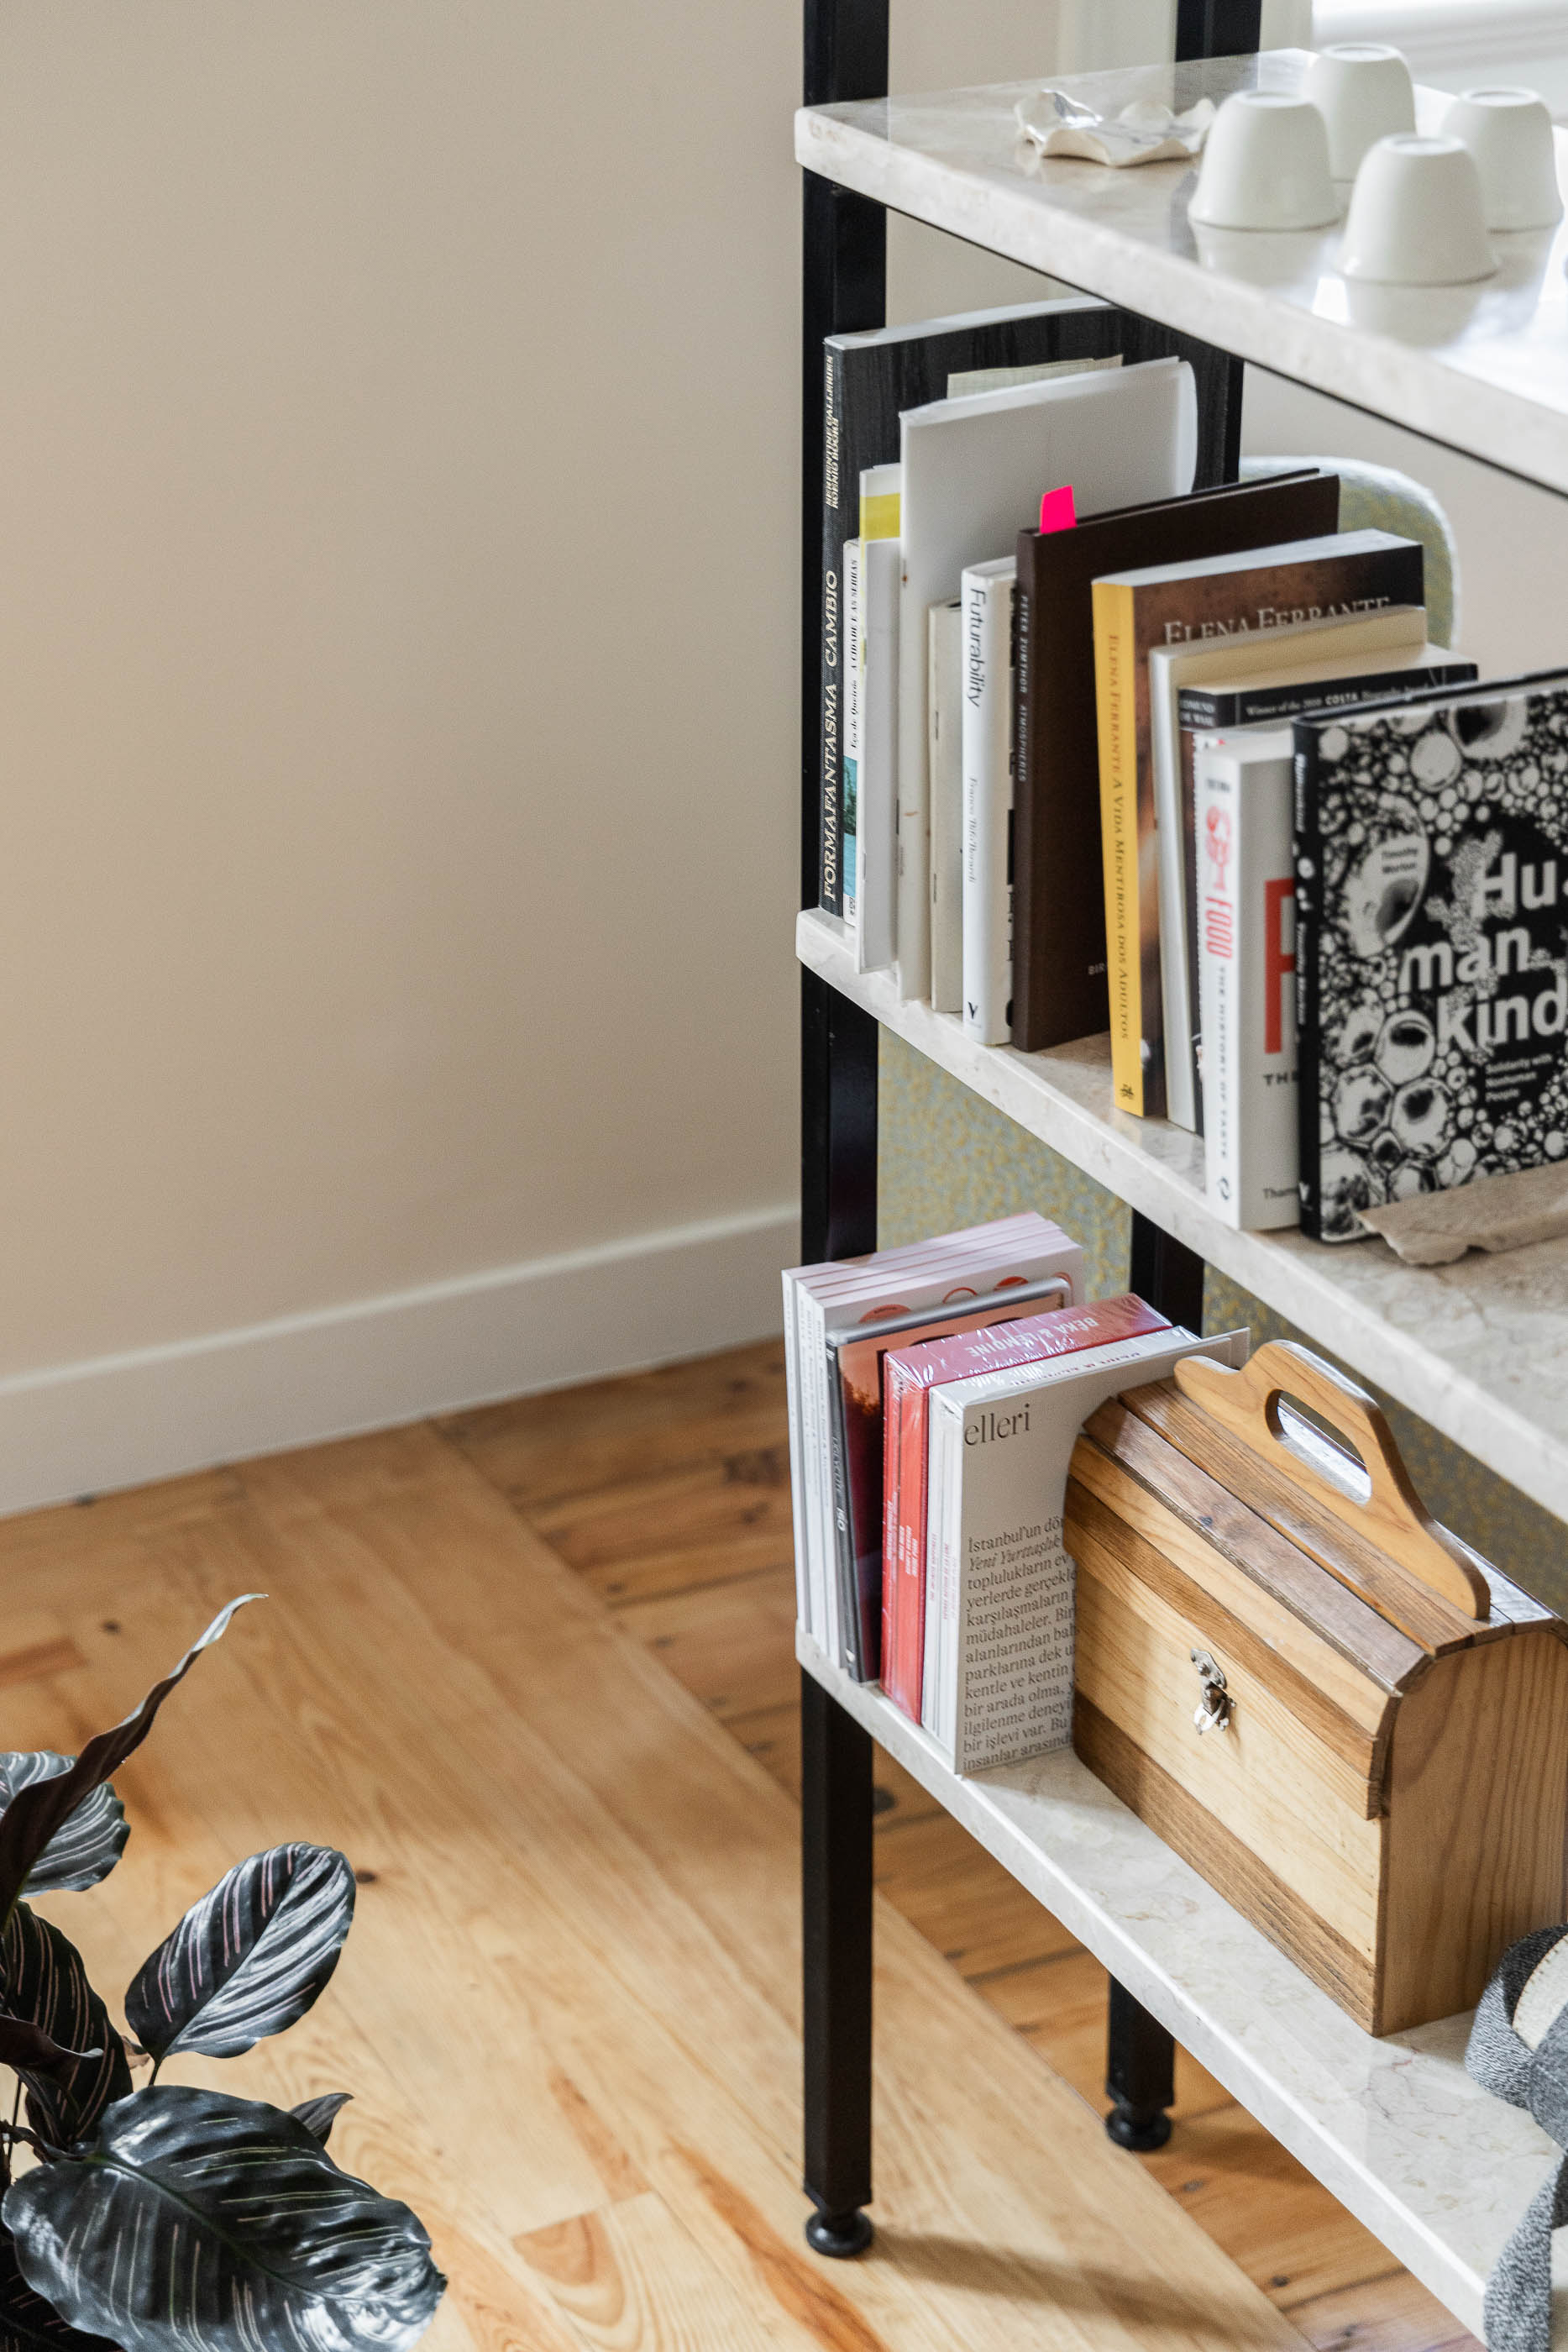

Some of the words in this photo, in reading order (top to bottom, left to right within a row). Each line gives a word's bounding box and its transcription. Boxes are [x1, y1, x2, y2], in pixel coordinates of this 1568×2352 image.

[825, 570, 837, 667] CAMBIO
[1020, 595, 1028, 633] PETER
[965, 587, 987, 708] Futurability
[1019, 637, 1028, 694] ZUMTHOR
[1324, 692, 1358, 706] COSTA
[1018, 704, 1028, 782] ATMOSPHERES
[823, 683, 837, 901] FORMAFANTASMA
[1204, 895, 1234, 960] FOOD
[1397, 927, 1531, 994] man
[1217, 966, 1228, 998] THE
[1217, 1003, 1229, 1075] HISTORY
[1219, 1109, 1229, 1160] TASTE
[963, 1331, 1038, 1357] LEMOINE
[964, 1403, 1031, 1446] elleri
[968, 1551, 998, 1572] Yeni
[968, 1558, 1051, 1591] toplulukların
[966, 1584, 1022, 1613] yerlerde
[967, 1590, 1068, 1627] karşılaşmaların
[965, 1633, 1050, 1663] alanlarından
[965, 1656, 1036, 1685] parklarına
[1038, 1646, 1062, 1665] dek
[964, 1679, 1008, 1700] kentle
[1009, 1677, 1025, 1690] ve
[1027, 1662, 1069, 1685] kentin
[963, 1712, 1025, 1736] ilgilenme
[964, 1701, 985, 1718] bir
[986, 1693, 1025, 1714] arada
[963, 1737, 985, 1754] bir
[985, 1726, 1020, 1751] işlevi
[963, 1747, 1020, 1772] insanlar
